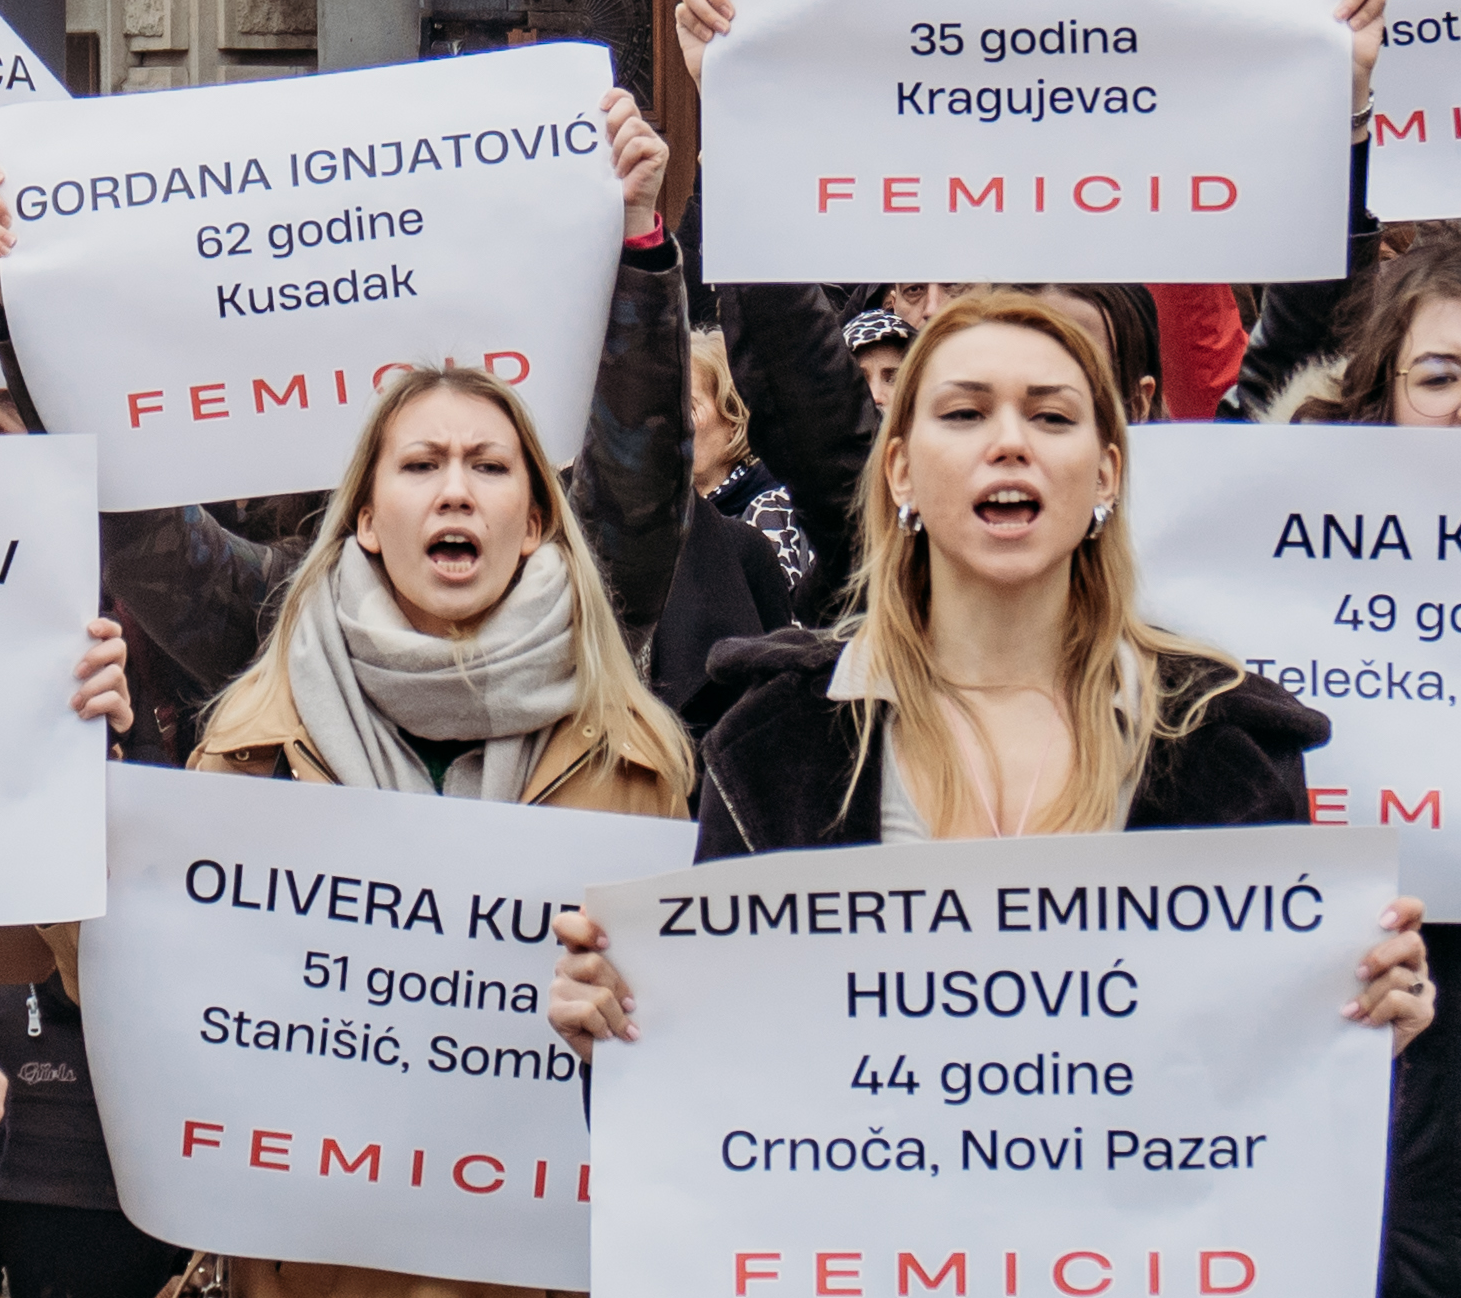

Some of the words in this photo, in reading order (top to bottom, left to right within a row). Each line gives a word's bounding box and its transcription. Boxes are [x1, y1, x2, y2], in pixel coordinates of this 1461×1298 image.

[911, 23, 963, 56] 35
[981, 20, 1137, 62] godina
[898, 79, 1156, 122] Kragujevac
[15, 158, 272, 224] GORDANA
[291, 113, 597, 187] IGNJATOVIĆ
[819, 176, 1237, 212] FEMICID
[198, 223, 252, 259] 62
[269, 207, 423, 259] godine
[218, 265, 417, 318] Kusadak
[1274, 514, 1411, 560] ANA
[1335, 594, 1396, 632] 49
[186, 860, 443, 934] OLIVERA
[660, 890, 971, 936] ZUMERTA
[998, 874, 1322, 932] EMINOVIĆ
[304, 951, 348, 991] 51
[367, 968, 537, 1013] godina
[848, 959, 1137, 1018] HUSOVIĆ
[201, 1007, 409, 1073] Stanišić,
[426, 1036, 589, 1085] Somb
[851, 1055, 919, 1095] 44
[941, 1052, 1132, 1105] godine
[181, 1119, 590, 1204] FEMICI
[723, 1127, 938, 1176] Crnoča,
[963, 1127, 1082, 1170] Novi
[1108, 1130, 1266, 1171] Pazar
[736, 1251, 1255, 1296] FEMICID
